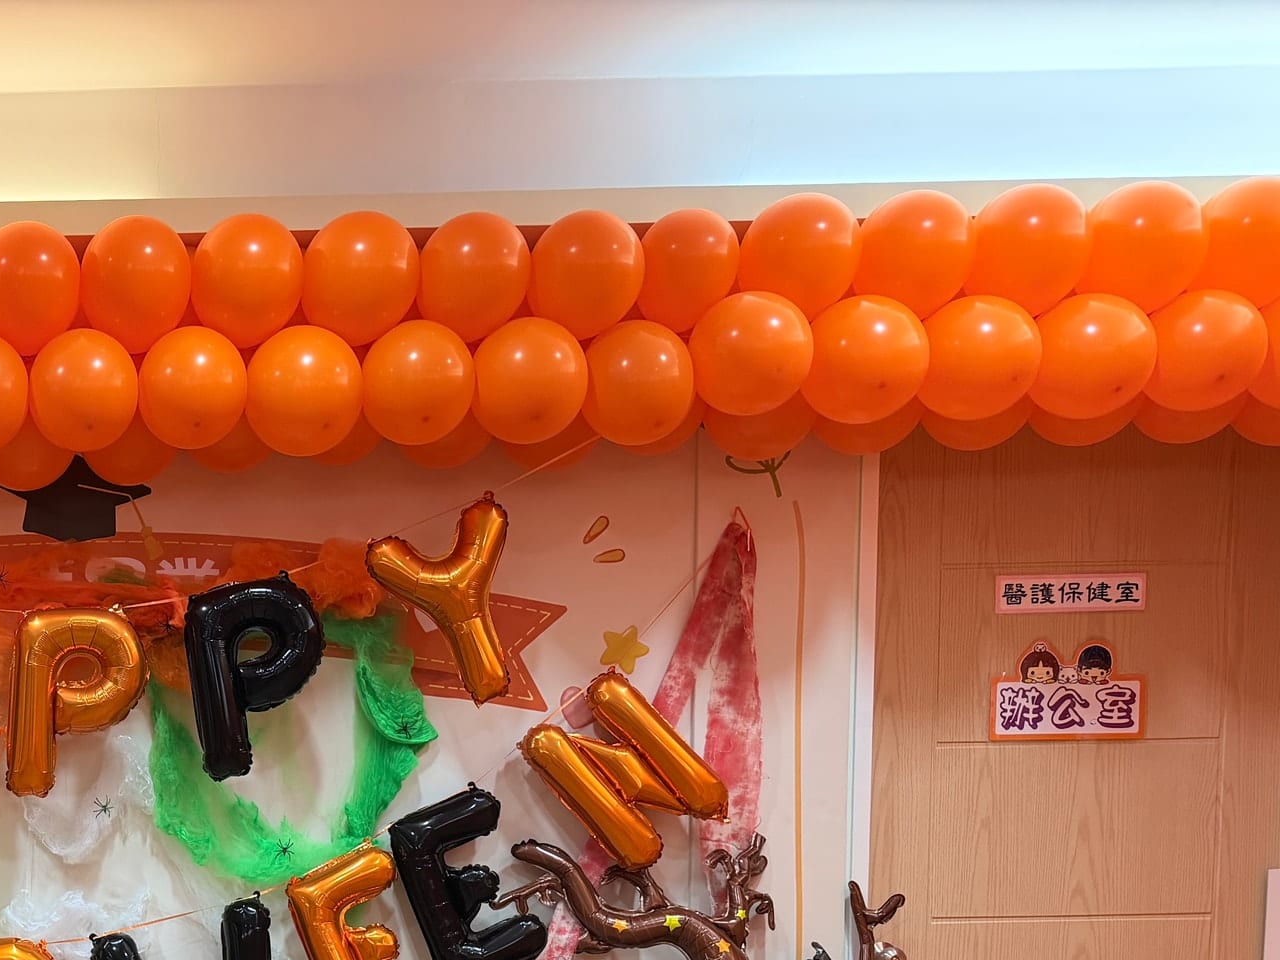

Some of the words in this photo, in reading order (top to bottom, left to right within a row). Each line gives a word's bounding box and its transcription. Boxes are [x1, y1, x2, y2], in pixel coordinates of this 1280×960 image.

[1002, 581, 1140, 606] 醫護保健室
[1000, 684, 1137, 730] 辦公室
